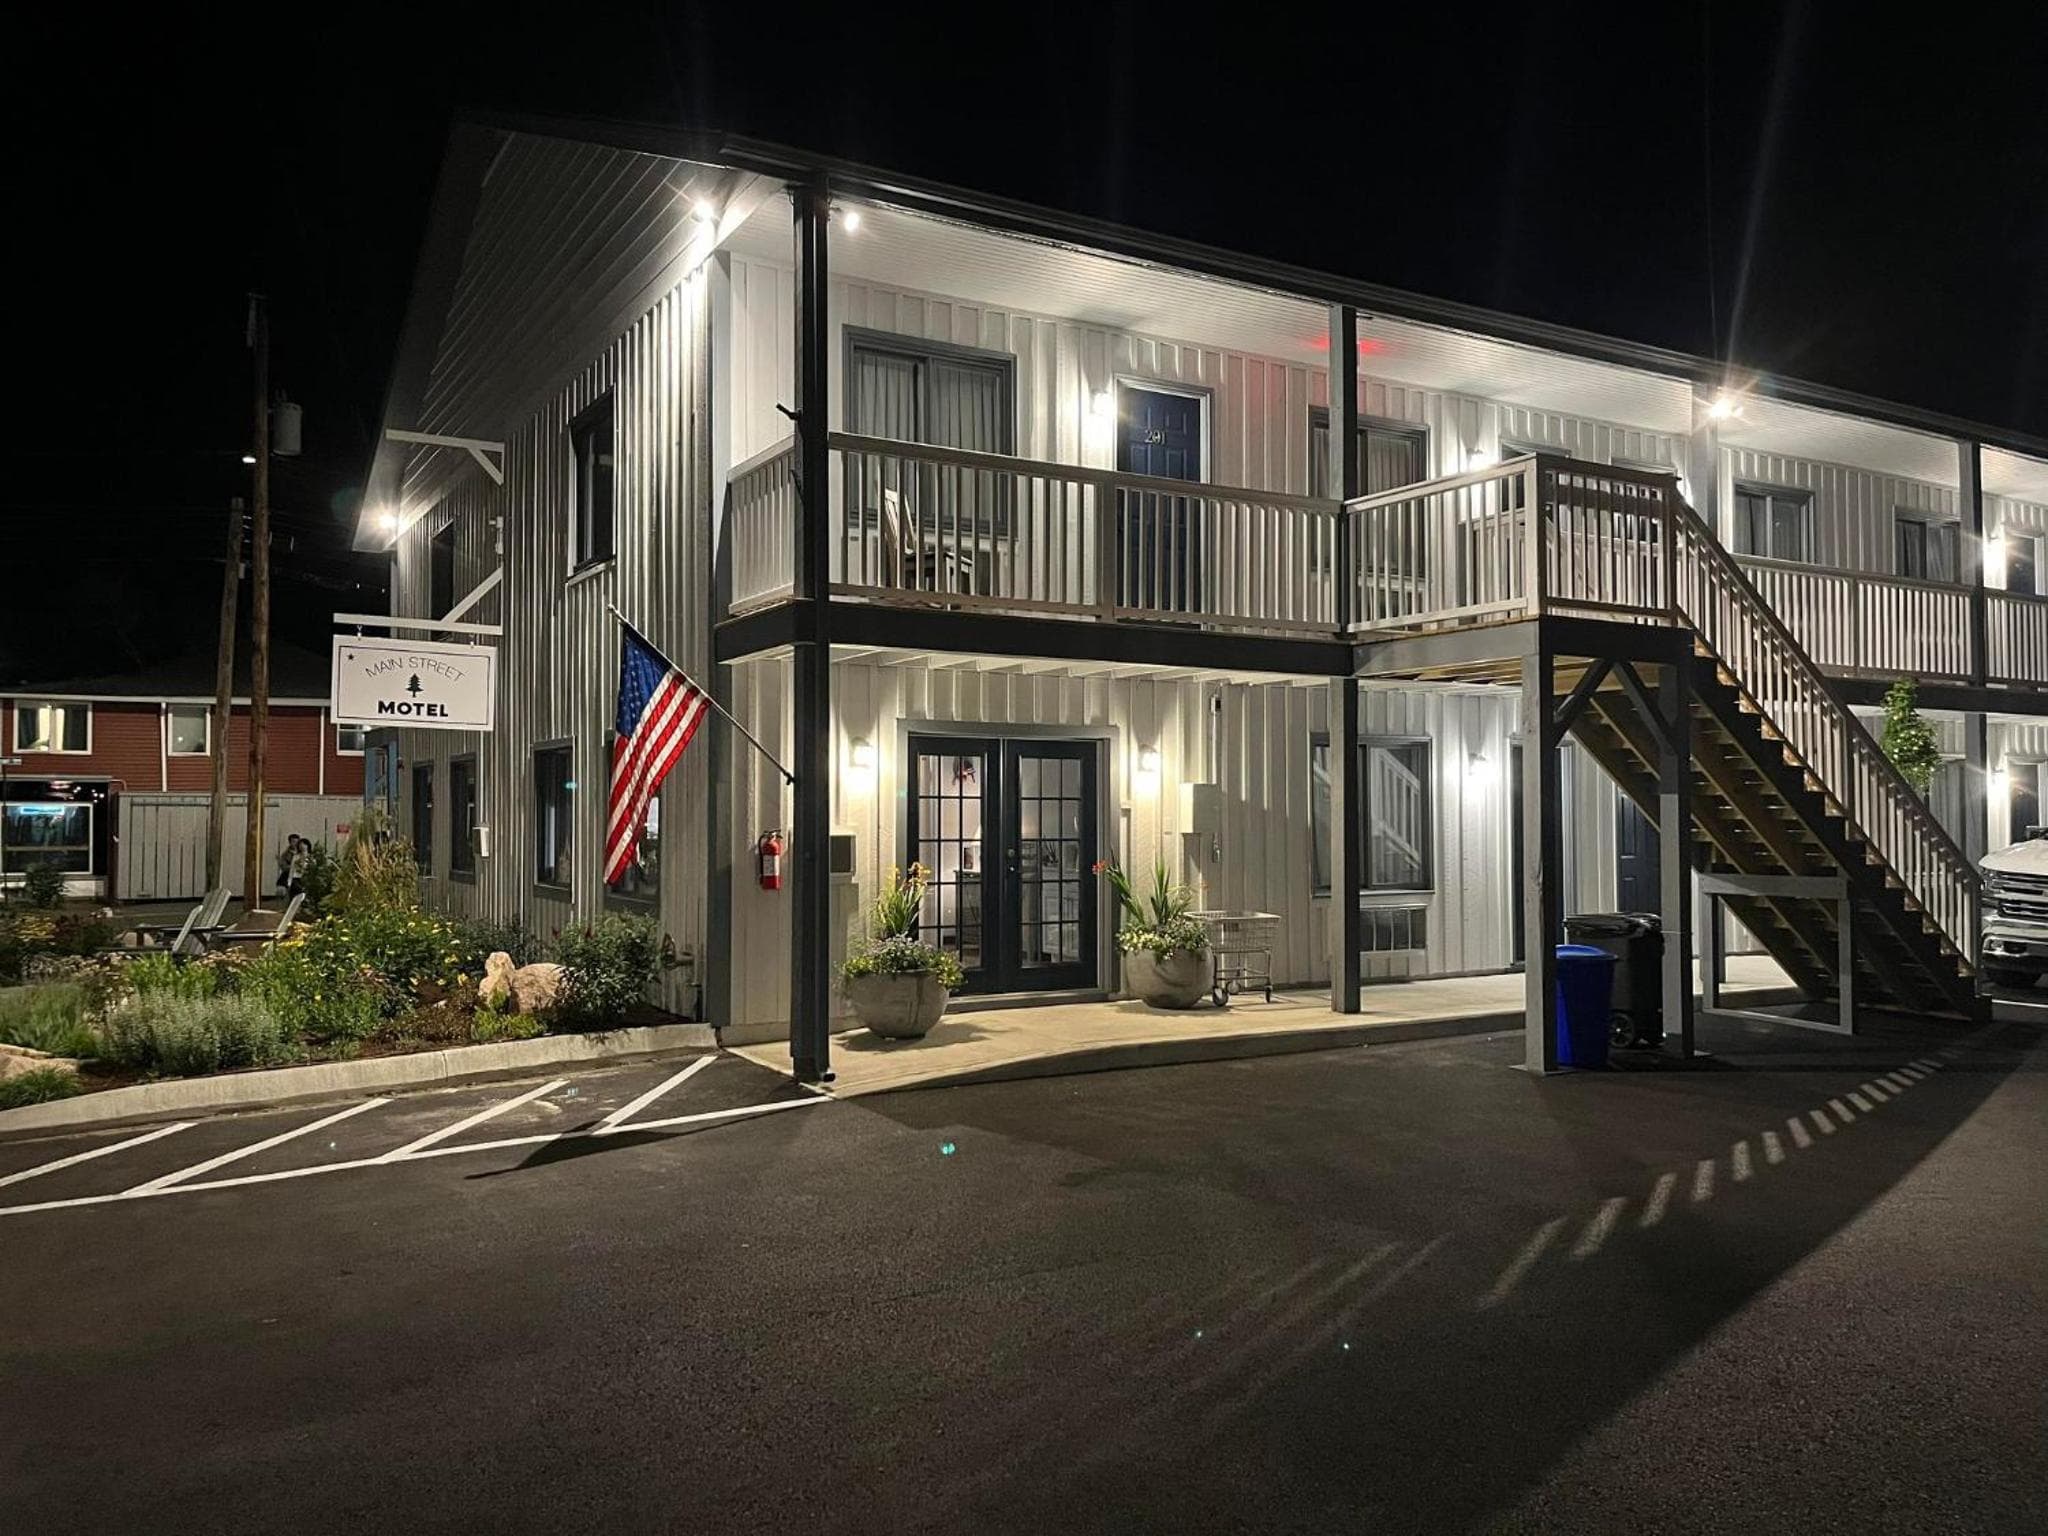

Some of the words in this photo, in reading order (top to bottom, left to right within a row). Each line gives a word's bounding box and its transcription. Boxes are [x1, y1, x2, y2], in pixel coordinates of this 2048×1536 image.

[365, 657, 403, 678] MAIN
[408, 656, 466, 682] STREET
[378, 700, 449, 717] MOTEL
